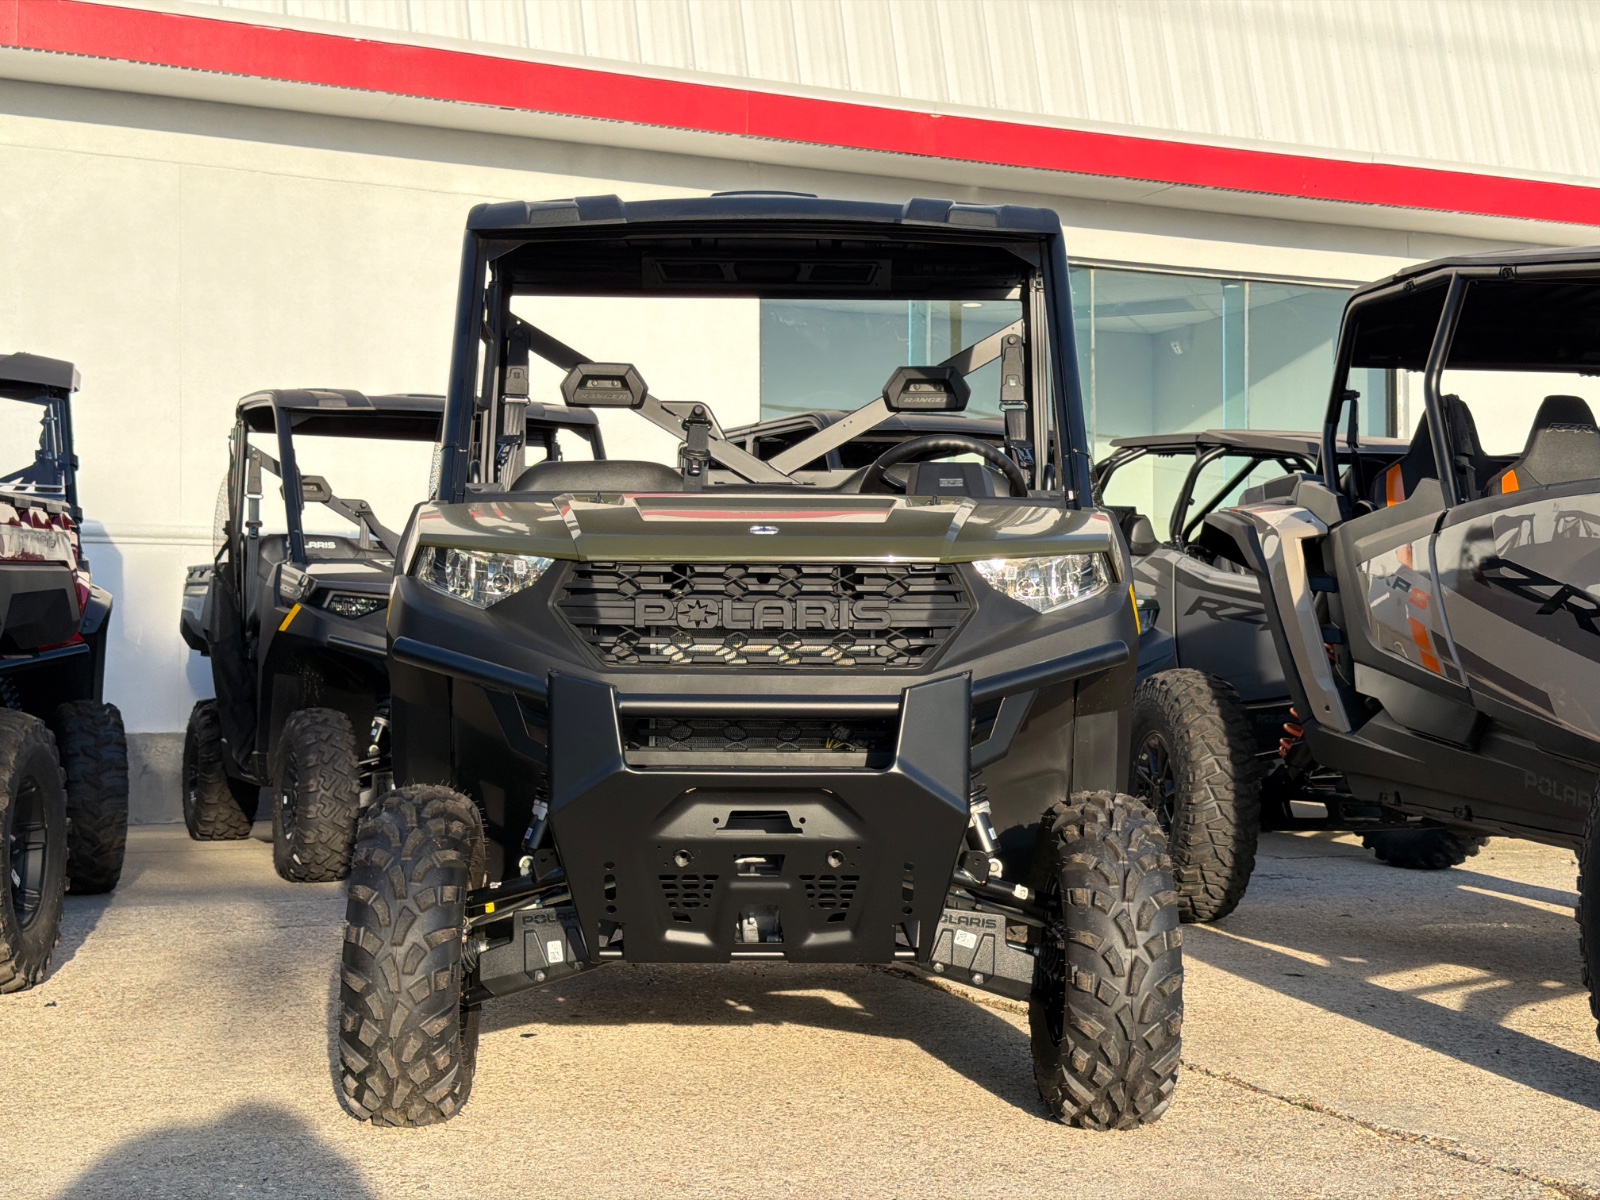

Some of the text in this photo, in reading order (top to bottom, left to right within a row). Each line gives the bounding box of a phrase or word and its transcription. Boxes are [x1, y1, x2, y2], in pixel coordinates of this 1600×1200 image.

[1545, 422, 1594, 434] RZR
[634, 599, 892, 631] POLARIS
[1183, 595, 1271, 632] RZ
